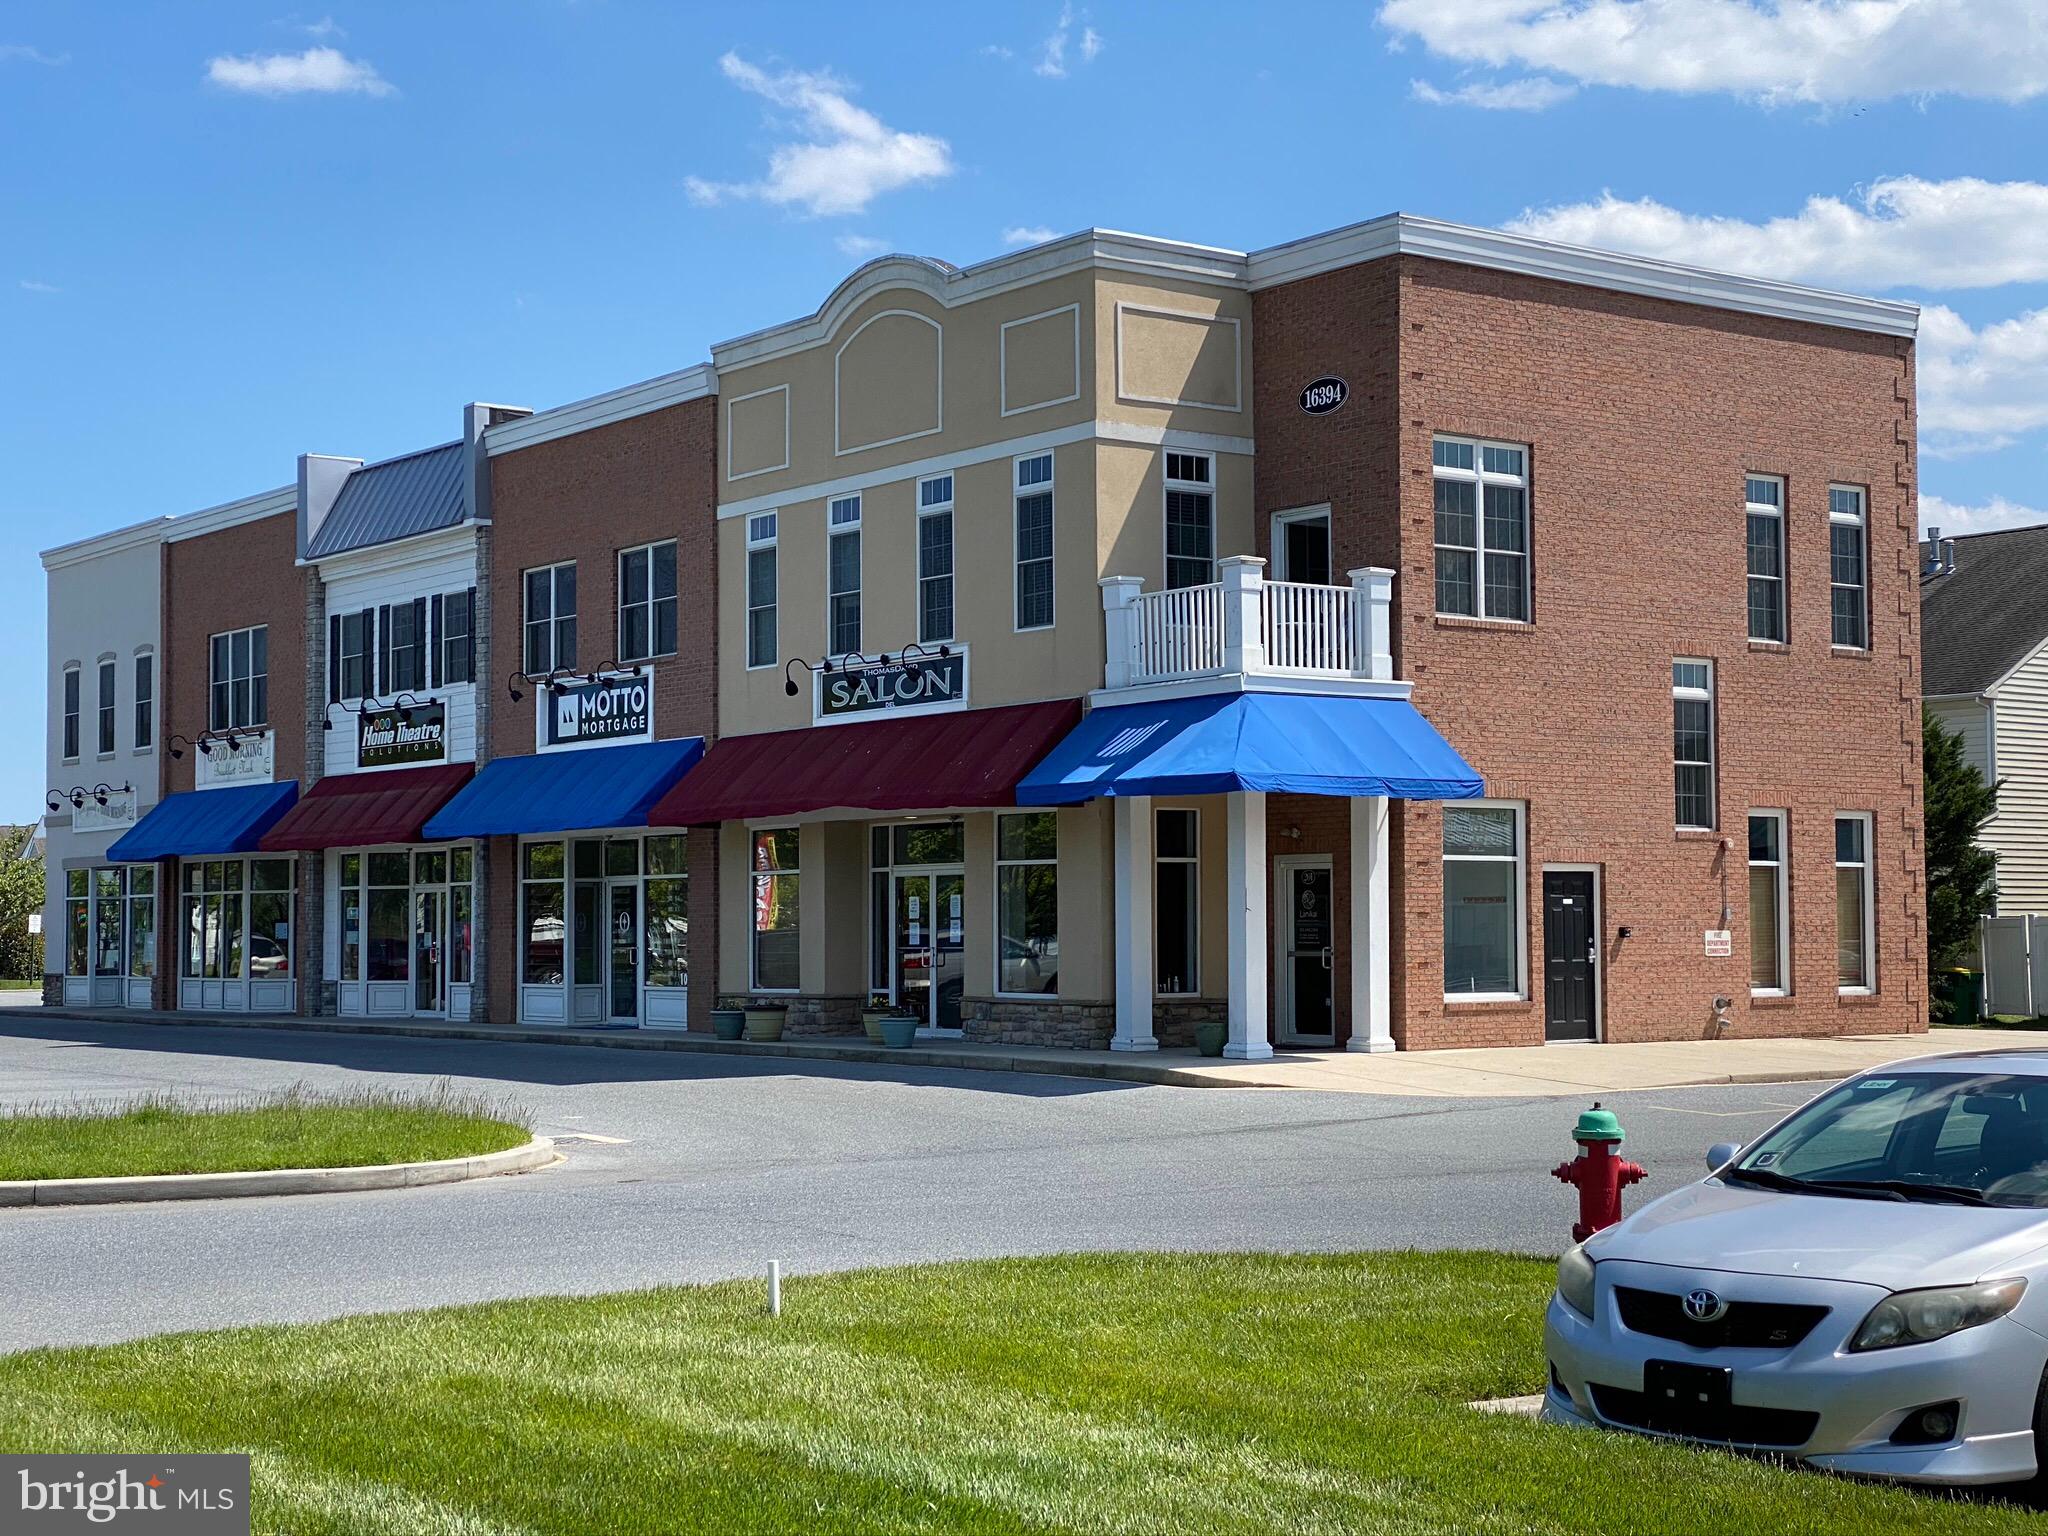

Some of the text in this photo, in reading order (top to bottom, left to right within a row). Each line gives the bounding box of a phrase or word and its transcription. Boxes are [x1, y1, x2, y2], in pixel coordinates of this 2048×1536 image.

[1305, 383, 1342, 409] 16394
[830, 667, 952, 708] SALON
[581, 685, 646, 719] MOTTO
[362, 721, 441, 747] Home Theatre
[581, 715, 646, 736] MORTGAGE
[207, 746, 228, 762] GOOD
[361, 742, 438, 758] SOLUTIONS
